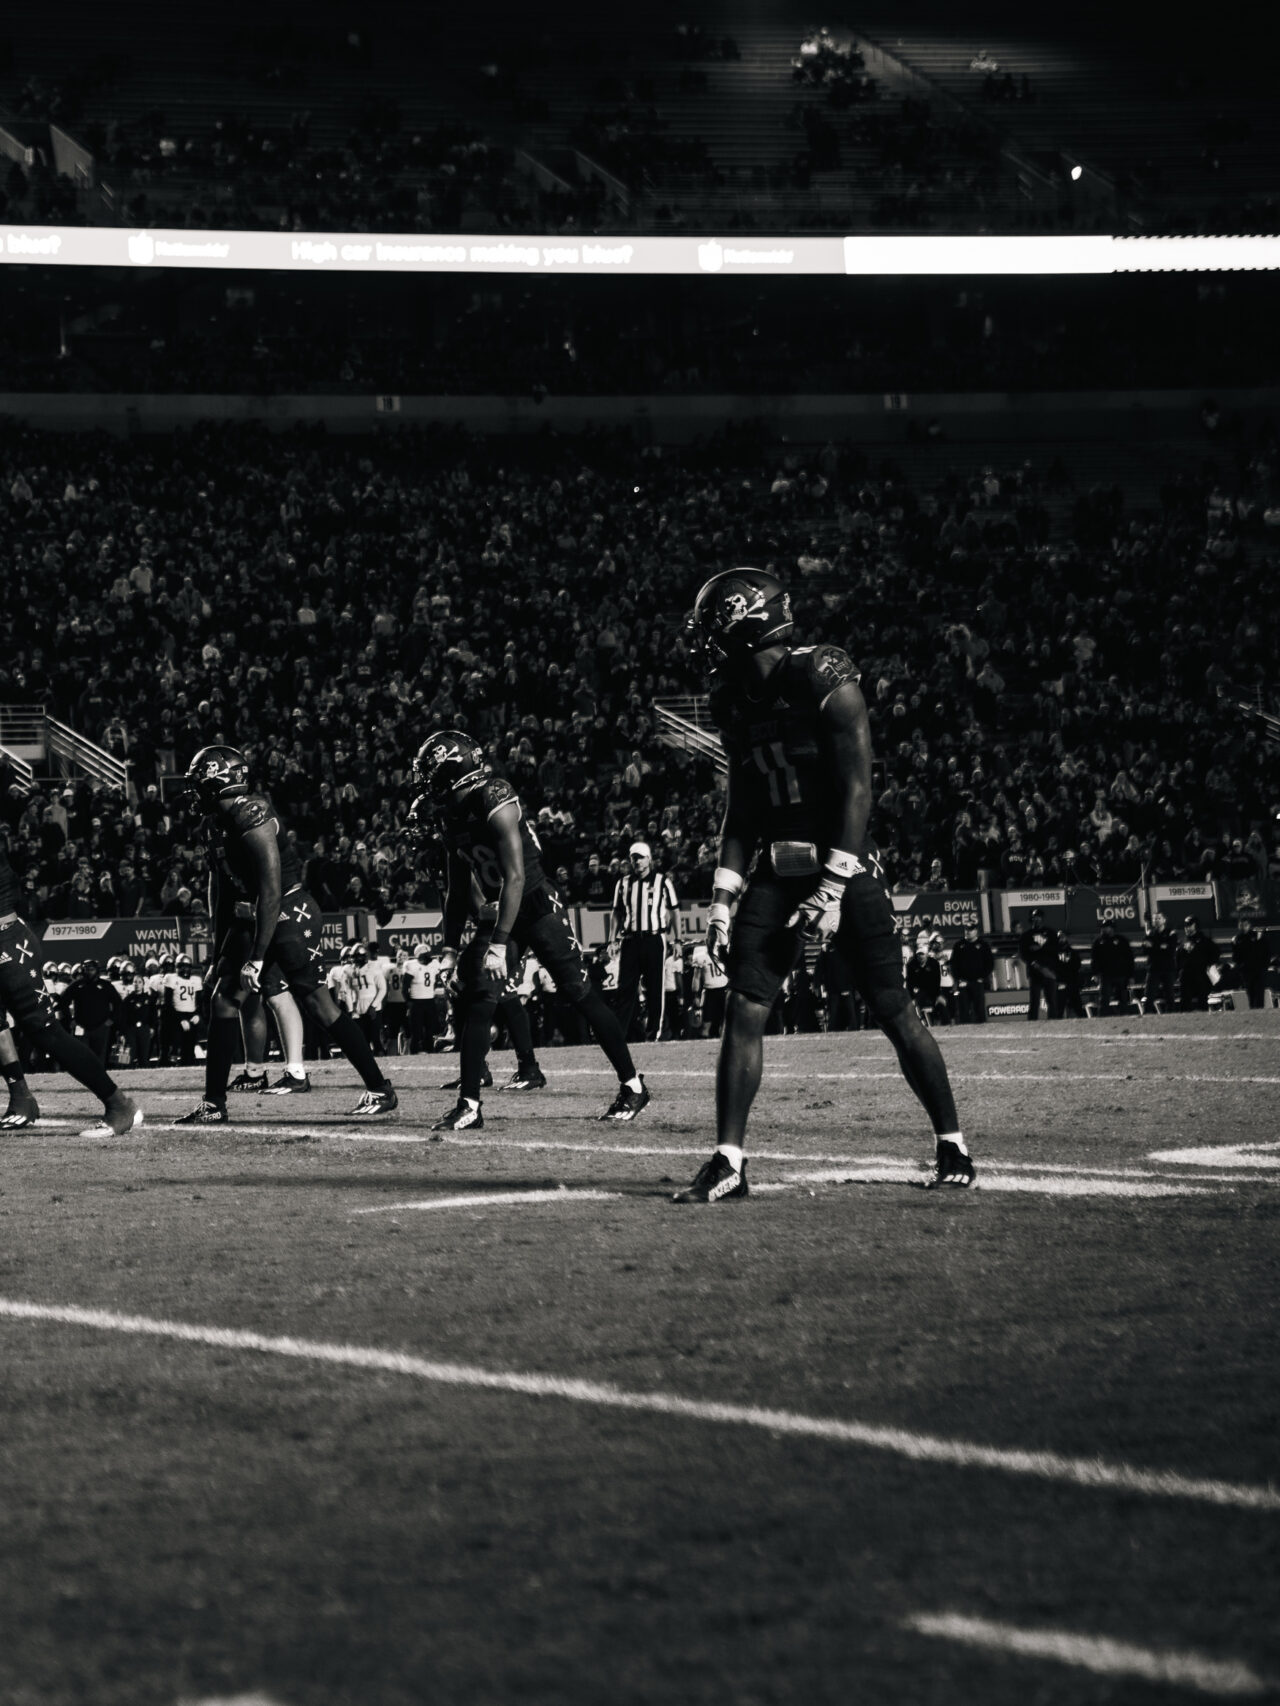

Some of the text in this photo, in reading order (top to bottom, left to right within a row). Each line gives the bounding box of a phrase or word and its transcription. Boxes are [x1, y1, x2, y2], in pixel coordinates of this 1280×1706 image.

[752, 741, 802, 807] 11
[944, 900, 978, 912] BOWL
[1099, 894, 1134, 906] TERRY
[895, 913, 979, 929] PEAANCES
[1096, 907, 1135, 921] LONG
[52, 926, 97, 936] 1977-1980
[135, 929, 179, 940] WAYNE
[128, 943, 181, 957] INMAN
[424, 972, 431, 987] 8
[179, 985, 195, 1001] 24
